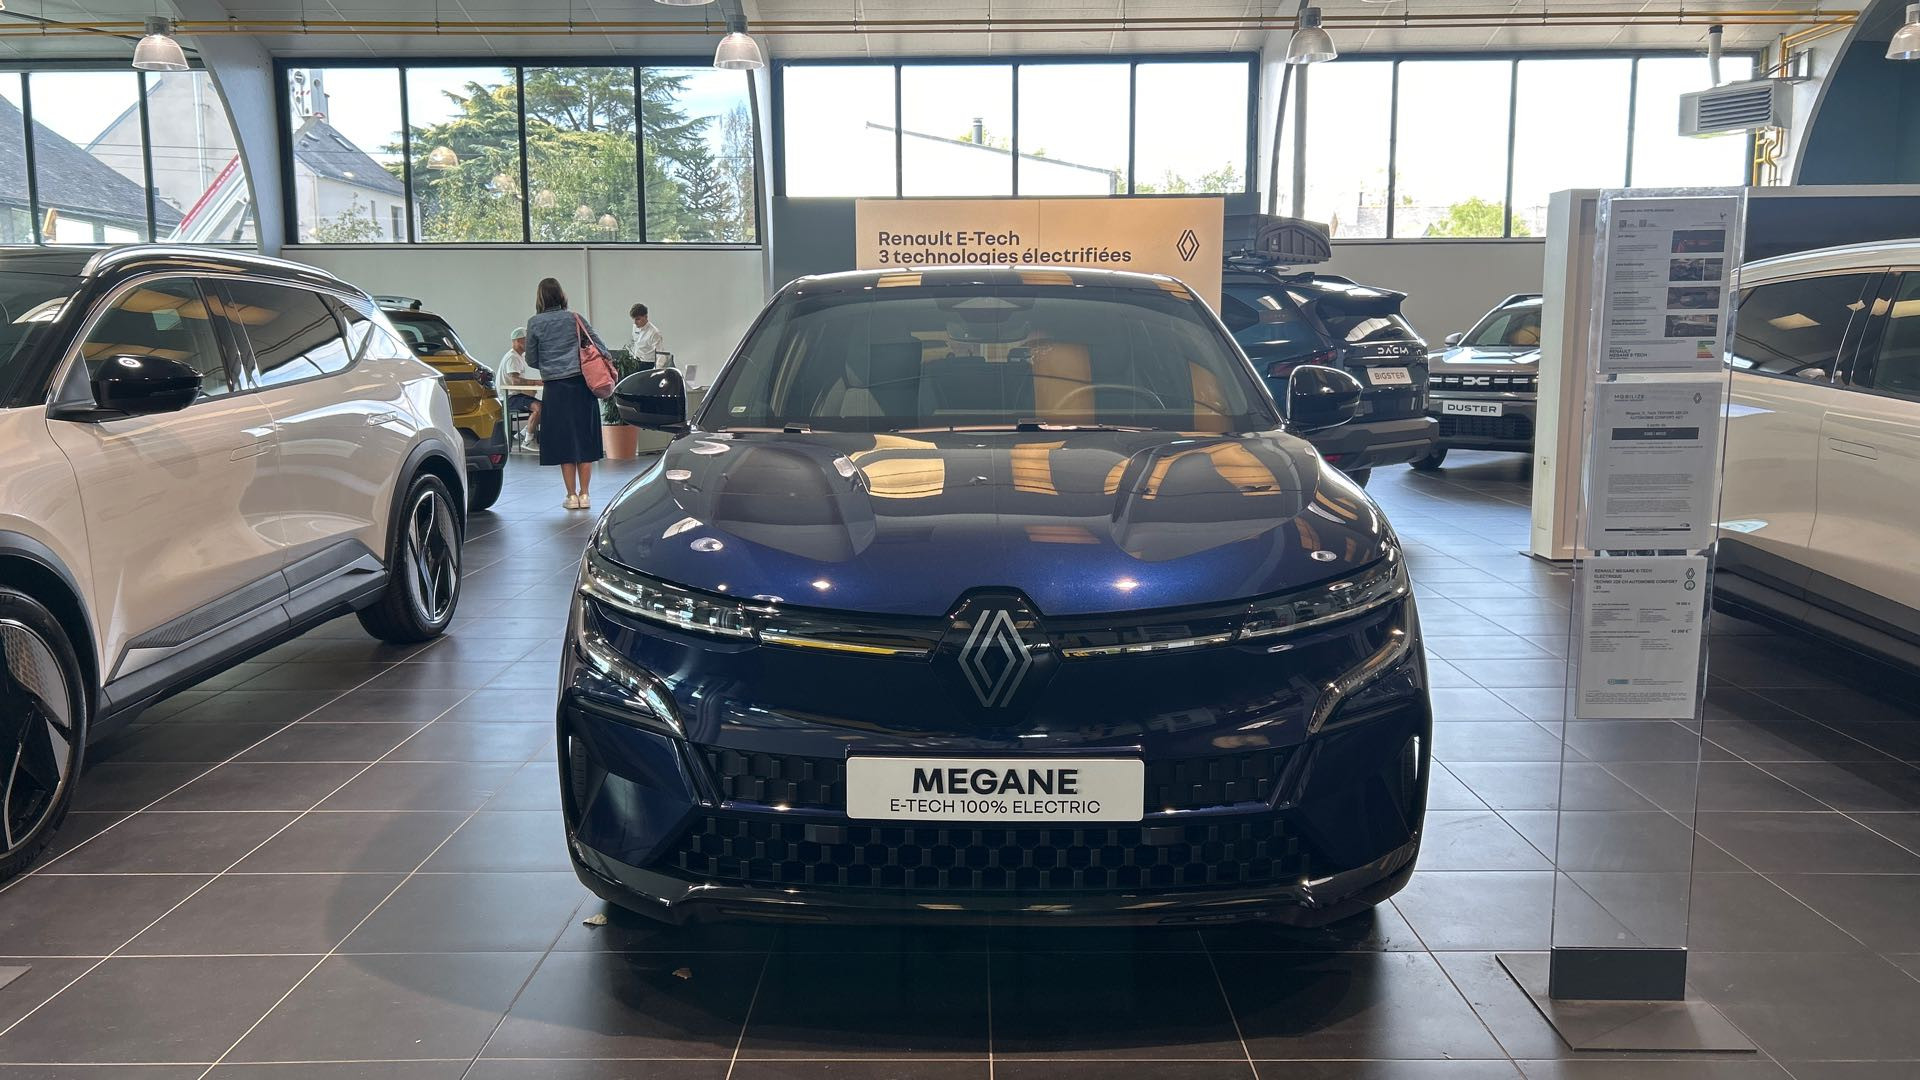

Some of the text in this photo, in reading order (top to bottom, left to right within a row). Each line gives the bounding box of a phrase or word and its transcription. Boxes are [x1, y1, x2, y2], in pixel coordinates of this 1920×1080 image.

[878, 231, 1020, 247] Renault E-Tech
[878, 247, 1132, 265] 3 technologies électrifiées
[1374, 371, 1406, 380] BIGSTER
[1447, 403, 1497, 413] DUSTER
[912, 768, 1078, 795] MEGANE
[890, 799, 1101, 814] E-TECH 100% ELECTRIC
